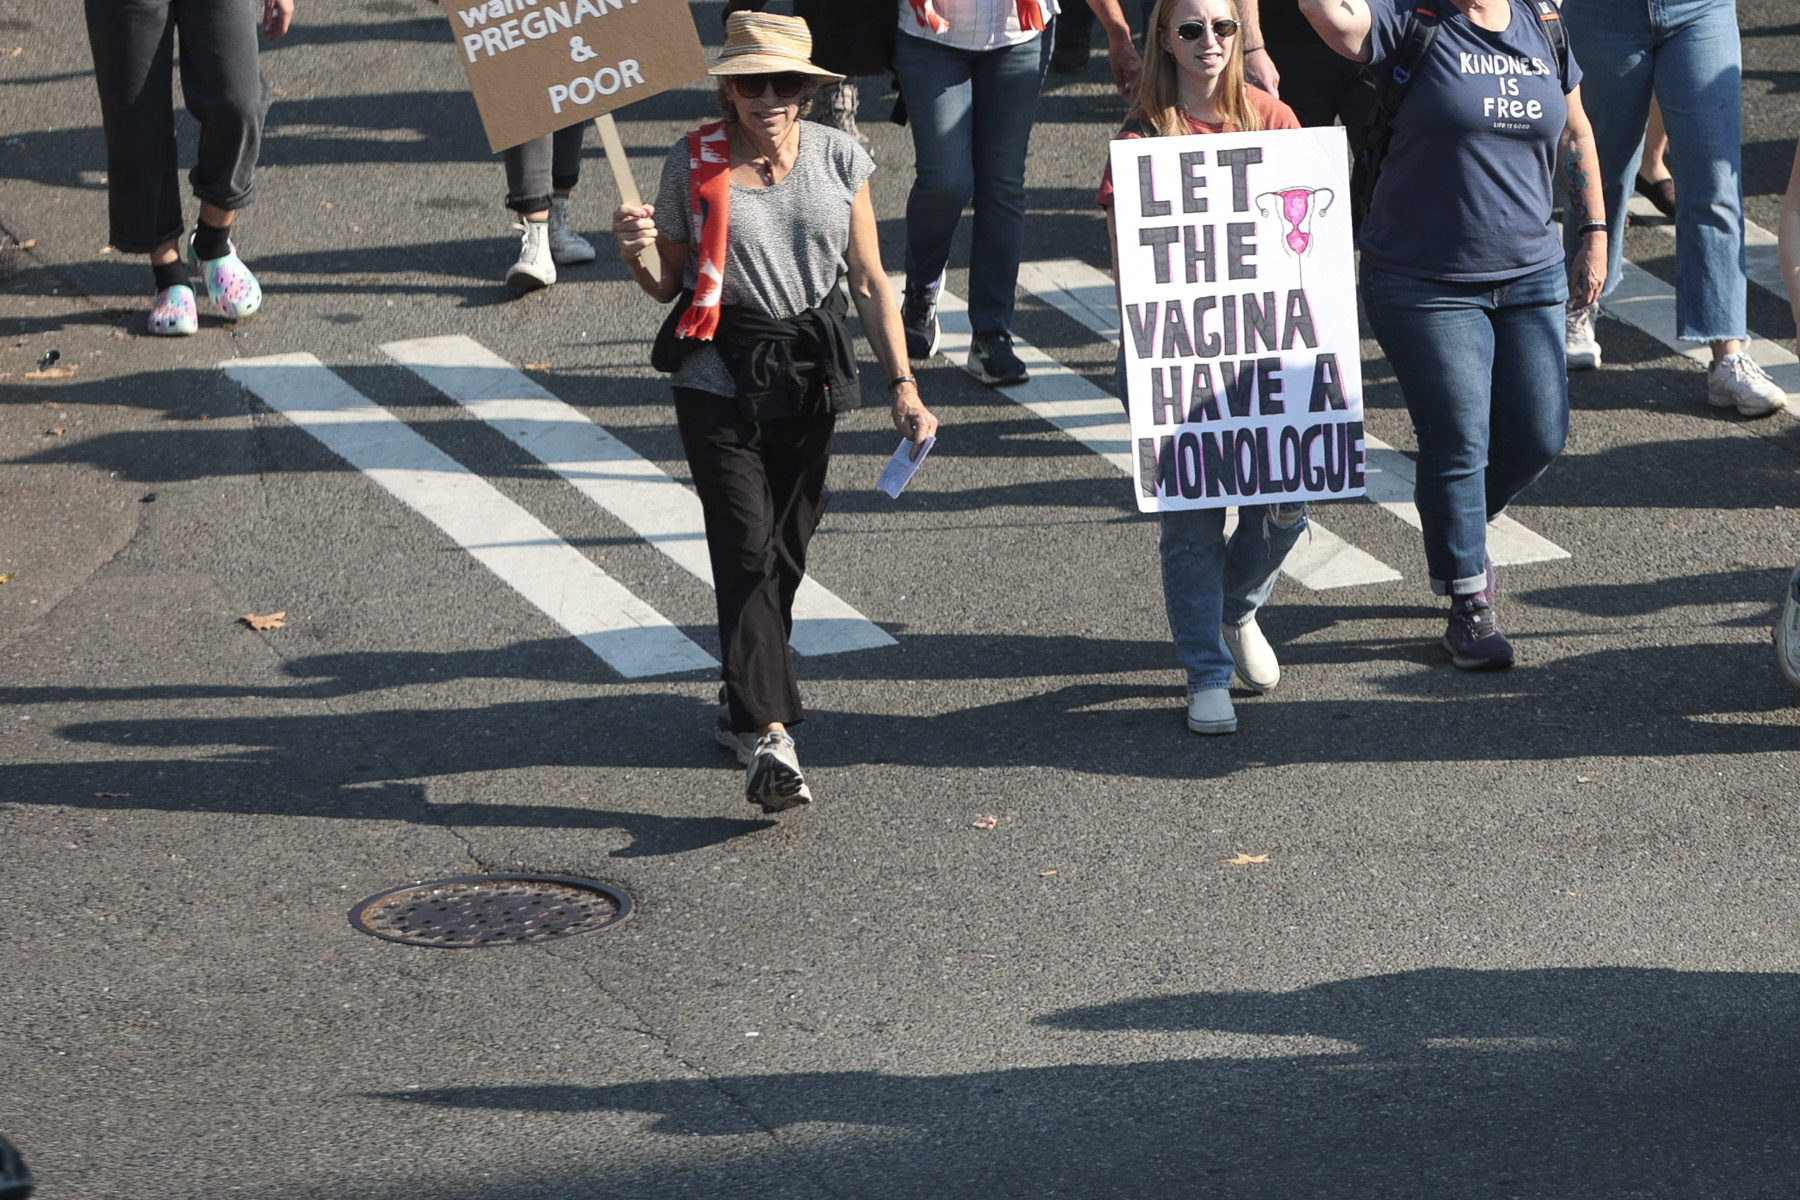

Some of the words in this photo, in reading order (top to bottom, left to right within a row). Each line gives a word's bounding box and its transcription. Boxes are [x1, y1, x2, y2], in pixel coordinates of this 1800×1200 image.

[569, 36, 599, 63] &
[1460, 52, 1551, 75] KINDNESS
[548, 58, 646, 114] POOR
[1500, 77, 1520, 96] IS
[1137, 147, 1264, 217] LET
[1139, 221, 1259, 284] THE
[1125, 288, 1320, 359] VAGINA
[1151, 357, 1287, 425] HAVE
[1308, 352, 1350, 413] A
[1138, 421, 1367, 500] MONOLOGUE
